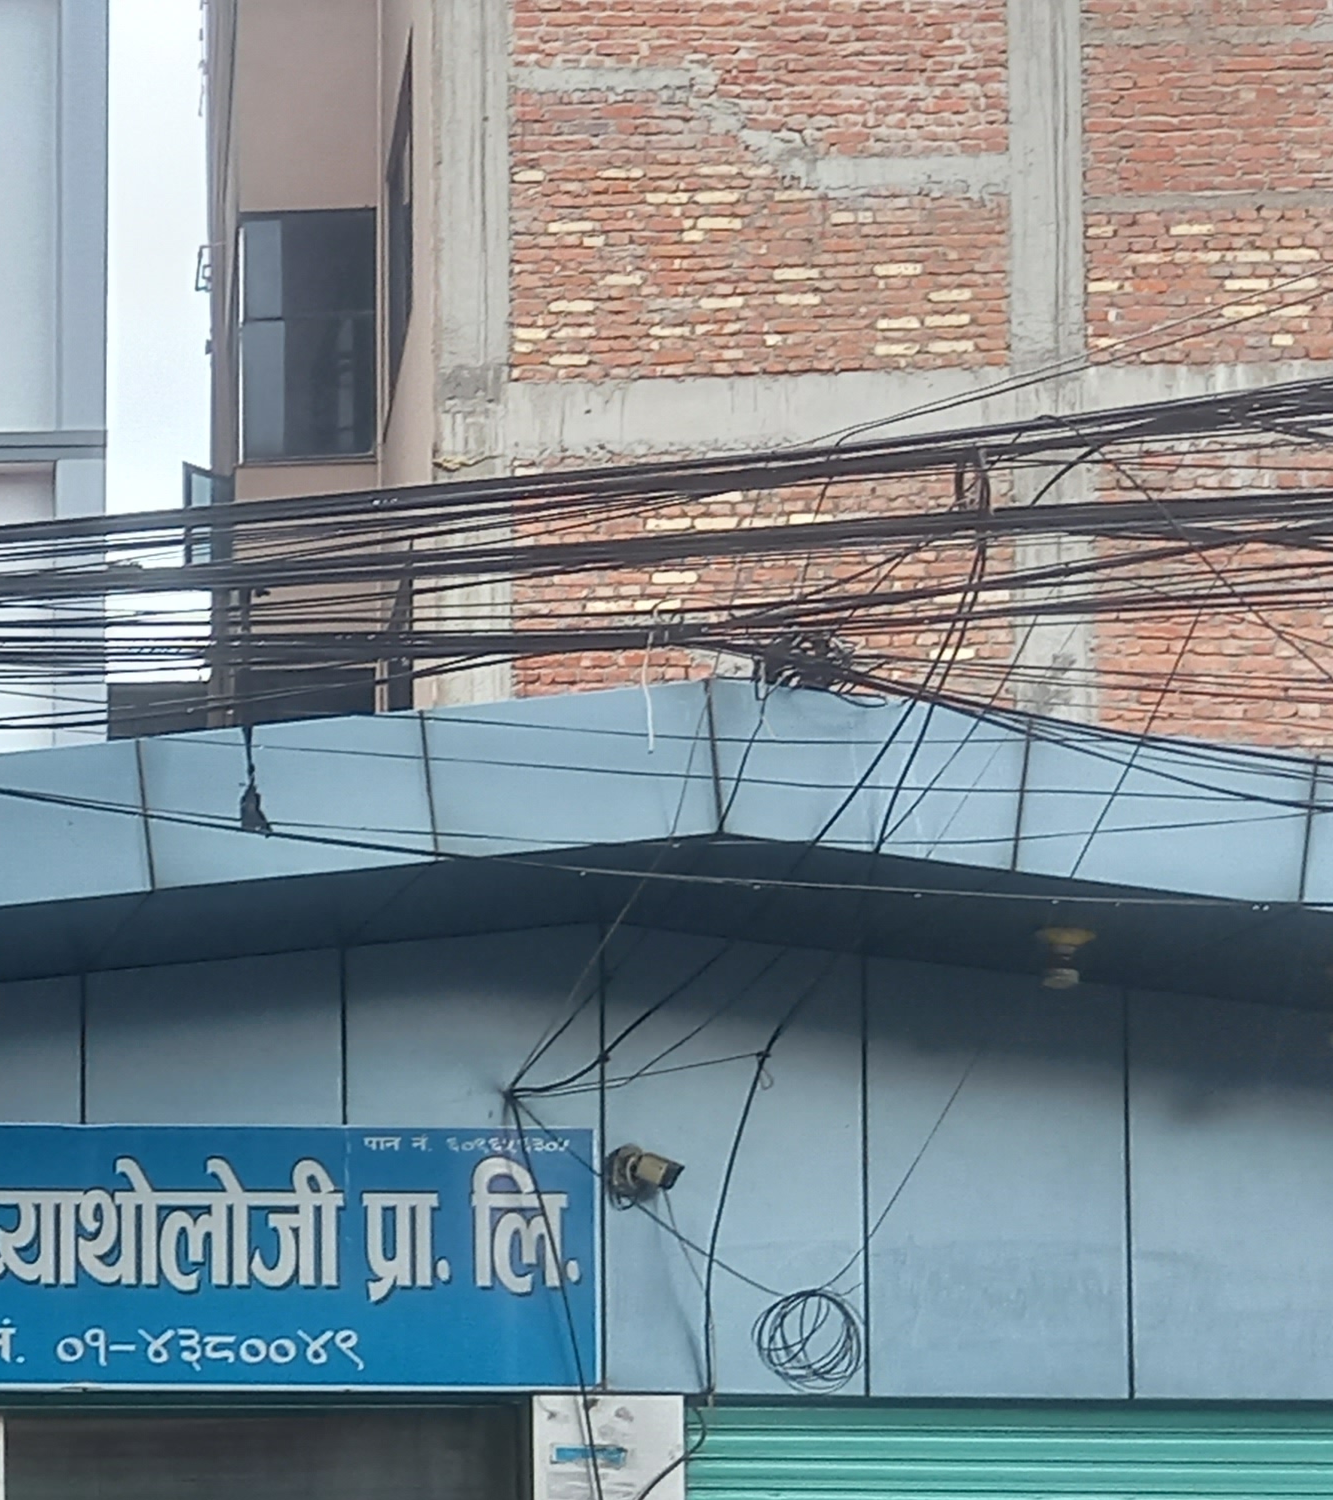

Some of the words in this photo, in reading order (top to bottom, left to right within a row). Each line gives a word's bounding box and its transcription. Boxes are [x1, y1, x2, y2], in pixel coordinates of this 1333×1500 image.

[361, 1188, 451, 1304] प्रा.
[473, 1155, 582, 1293] लि.
[56, 1327, 367, 1373] ०१-४३८००४९
